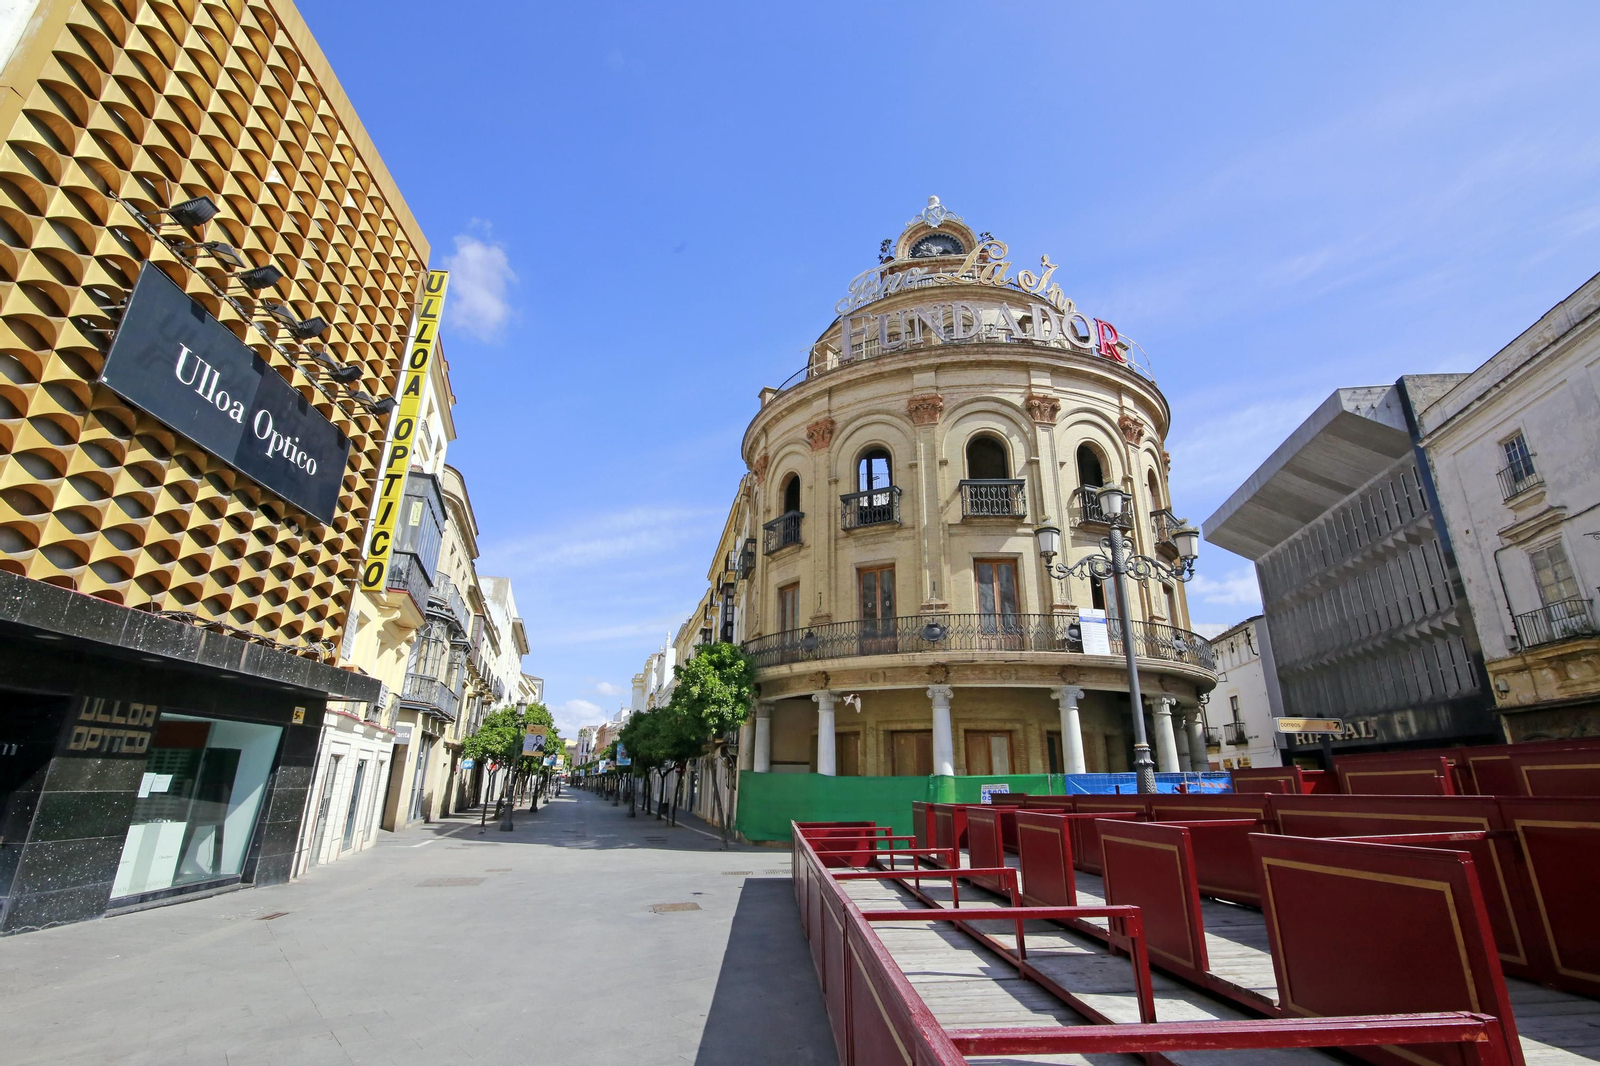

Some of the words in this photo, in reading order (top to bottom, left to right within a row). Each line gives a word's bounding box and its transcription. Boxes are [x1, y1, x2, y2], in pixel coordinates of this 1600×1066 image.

[834, 255, 929, 315] Fino
[933, 239, 1014, 286] La
[404, 273, 444, 396] ULLOA
[838, 302, 1128, 364] FUNDADOR
[175, 342, 245, 424] Ulloa
[253, 409, 318, 476] Optico
[363, 418, 413, 588] OPTICO
[68, 725, 152, 754] OPTICO
[79, 696, 157, 727] ULLOA
